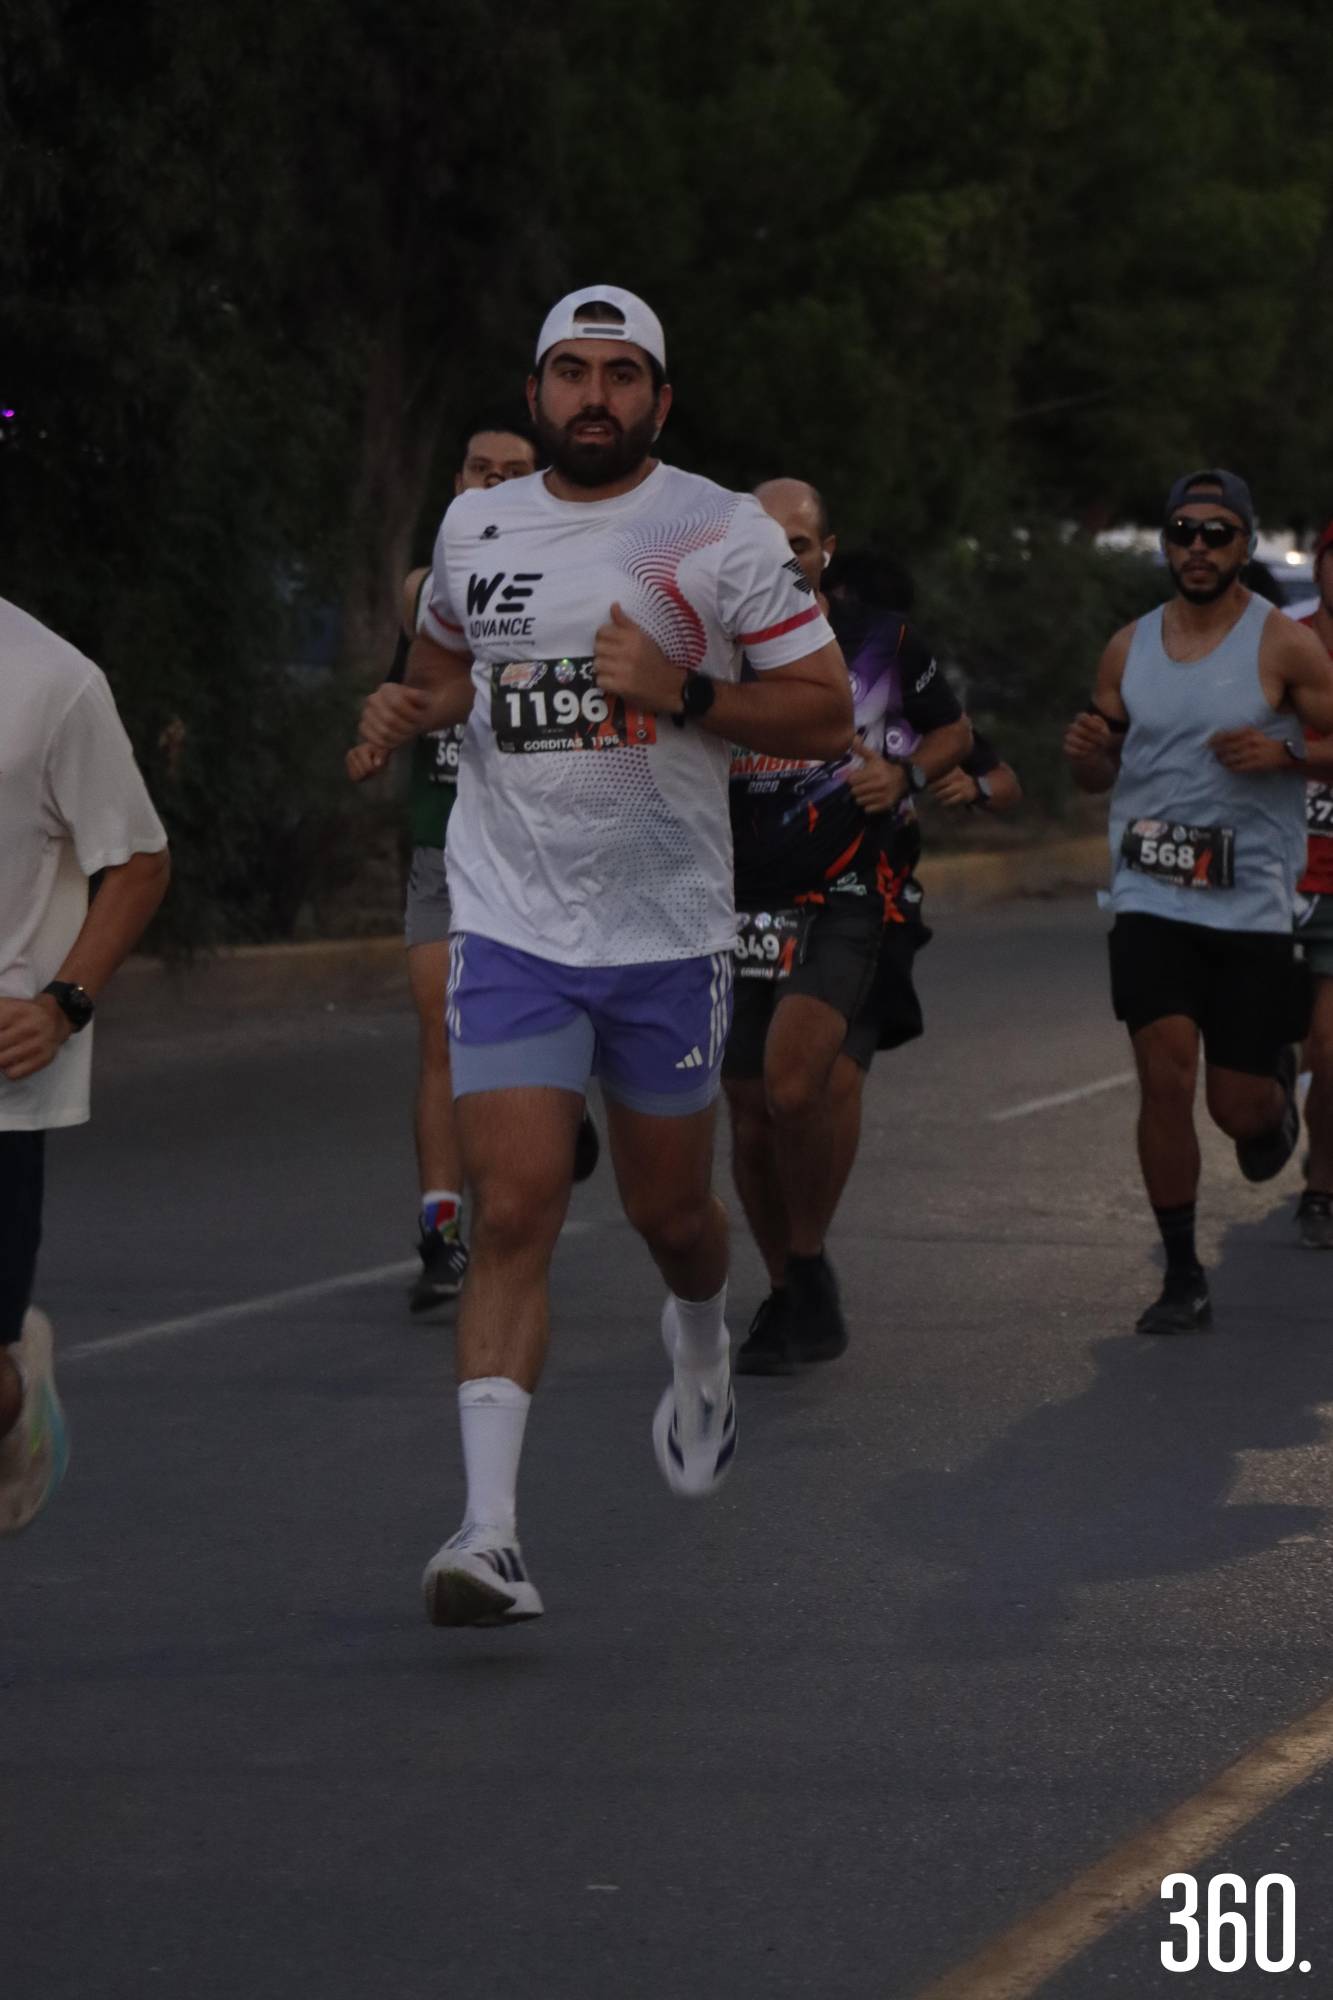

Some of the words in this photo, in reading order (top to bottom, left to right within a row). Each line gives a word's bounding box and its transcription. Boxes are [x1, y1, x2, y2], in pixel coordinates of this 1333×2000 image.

[466, 573, 543, 616] WE
[505, 688, 609, 729] 1196
[523, 737, 583, 751] GORDITAS
[591, 734, 620, 748] 1196
[1139, 840, 1195, 869] 568
[734, 933, 780, 961] 849
